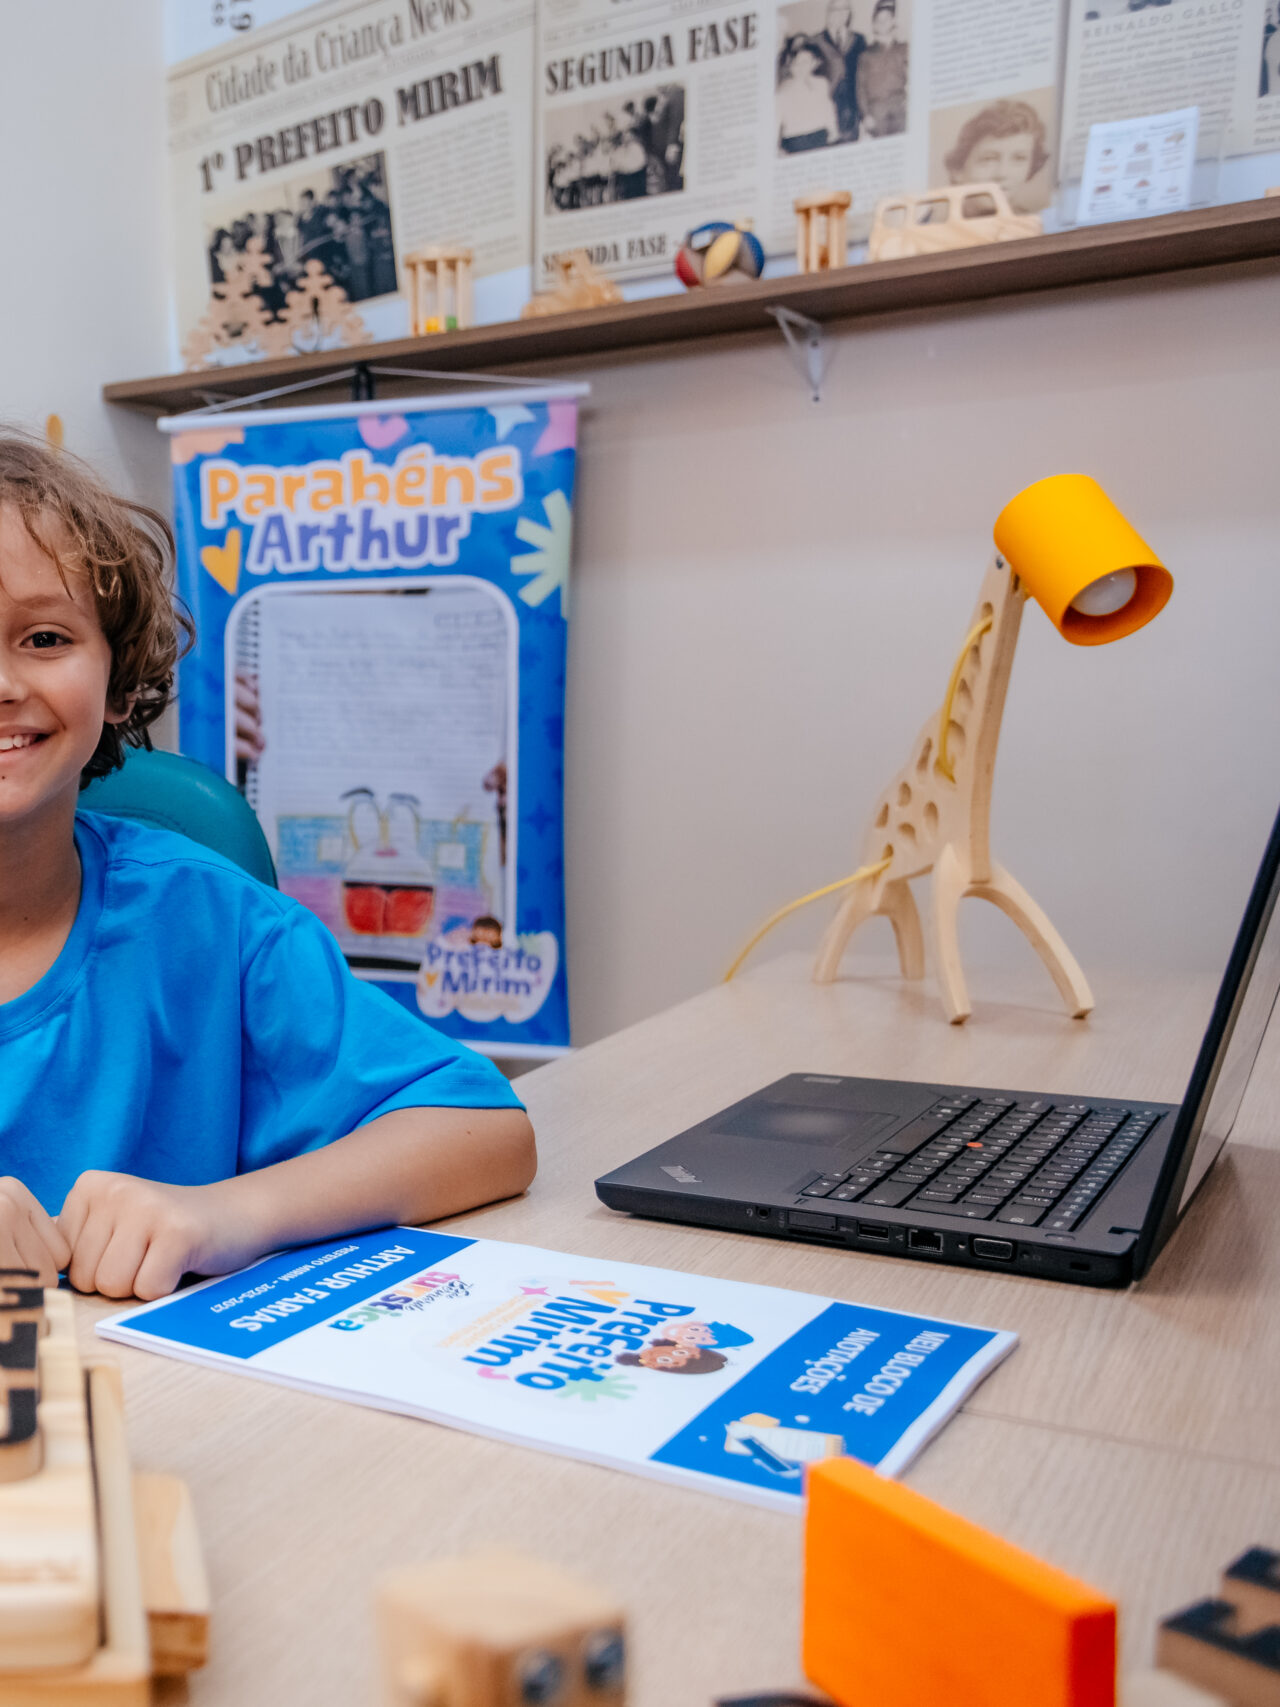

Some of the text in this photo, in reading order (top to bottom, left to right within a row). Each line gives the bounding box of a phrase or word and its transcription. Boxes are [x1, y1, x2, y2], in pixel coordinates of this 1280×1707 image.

[205, 0, 473, 112] Cidade da Criança News
[545, 13, 757, 95] SEGUNDA FASE
[234, 97, 384, 180] PREFEITO
[396, 54, 503, 126] MIRIM
[627, 232, 666, 259] FASE
[207, 452, 515, 520] Parabéns
[255, 508, 460, 564] Arthur
[442, 970, 531, 995] Mirim
[229, 1244, 416, 1332] ARTHUR FARIAS
[278, 1264, 315, 1282] MIRIM
[312, 1244, 360, 1265] PREFEITO
[462, 1296, 617, 1366] Mirim
[789, 1327, 880, 1395] ANOTAÇÕES
[842, 1330, 951, 1416] MEU BLOCO DE
